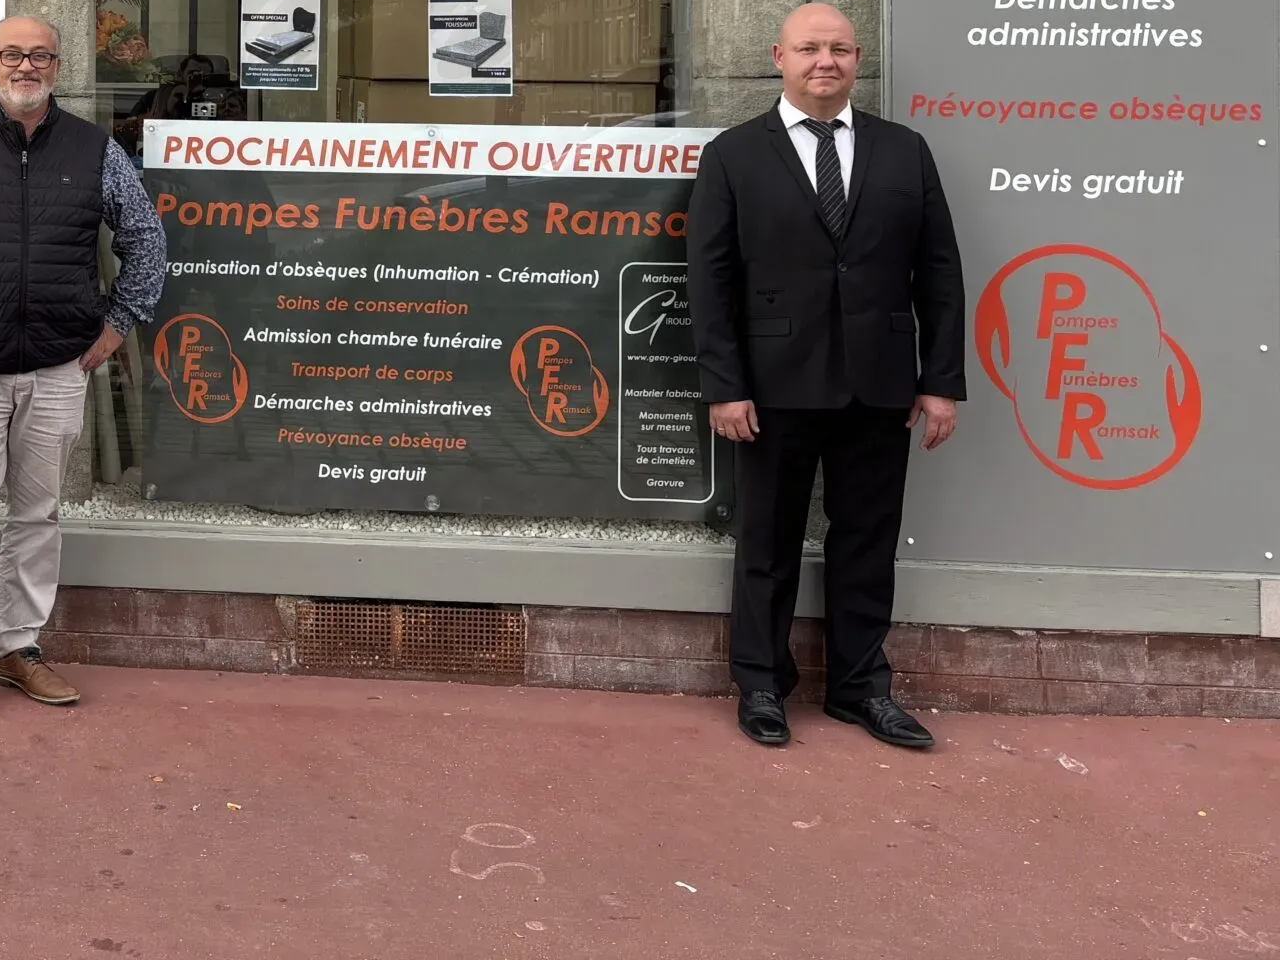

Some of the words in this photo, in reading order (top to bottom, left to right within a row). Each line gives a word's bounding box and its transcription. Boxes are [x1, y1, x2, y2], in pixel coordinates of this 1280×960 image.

[967, 22, 1203, 48] administratives
[909, 92, 1098, 124] Prévoyance
[1108, 94, 1263, 126] obsèques
[163, 135, 479, 171] PROCHAINEMENT
[487, 141, 700, 174] OUVERTURE
[988, 168, 1072, 193] Devis
[1082, 169, 1185, 199] gratuit
[155, 193, 321, 235] Pompes
[335, 194, 529, 234] Funèbres
[545, 202, 688, 237] Ramsa
[166, 259, 261, 277] rganisation
[265, 260, 368, 281] d'obsèques
[373, 263, 480, 283] (Inhumation
[498, 267, 600, 288] Crémation)
[641, 273, 688, 284] Marbreri
[276, 295, 321, 312] Soins
[325, 296, 349, 312] de
[354, 297, 469, 315] conservation
[243, 327, 332, 345] Admission
[337, 330, 419, 348] chambre
[423, 331, 503, 350] funéraire
[291, 362, 371, 381] Transport
[375, 365, 399, 381] de
[404, 368, 454, 385] corps
[624, 388, 664, 398] Marbrier
[253, 394, 354, 412] Démarches
[359, 398, 492, 417] administratives
[638, 411, 694, 421] Monuments
[277, 427, 384, 447] Prévoyance
[388, 432, 467, 452] obsèque
[656, 424, 691, 432] mesure
[635, 455, 649, 465] de
[651, 455, 696, 466] cimetière
[636, 444, 657, 454] Tous
[659, 445, 695, 454] travaux
[318, 463, 365, 480] Devis
[369, 466, 427, 484] gratuit
[646, 477, 685, 488] Gravure
